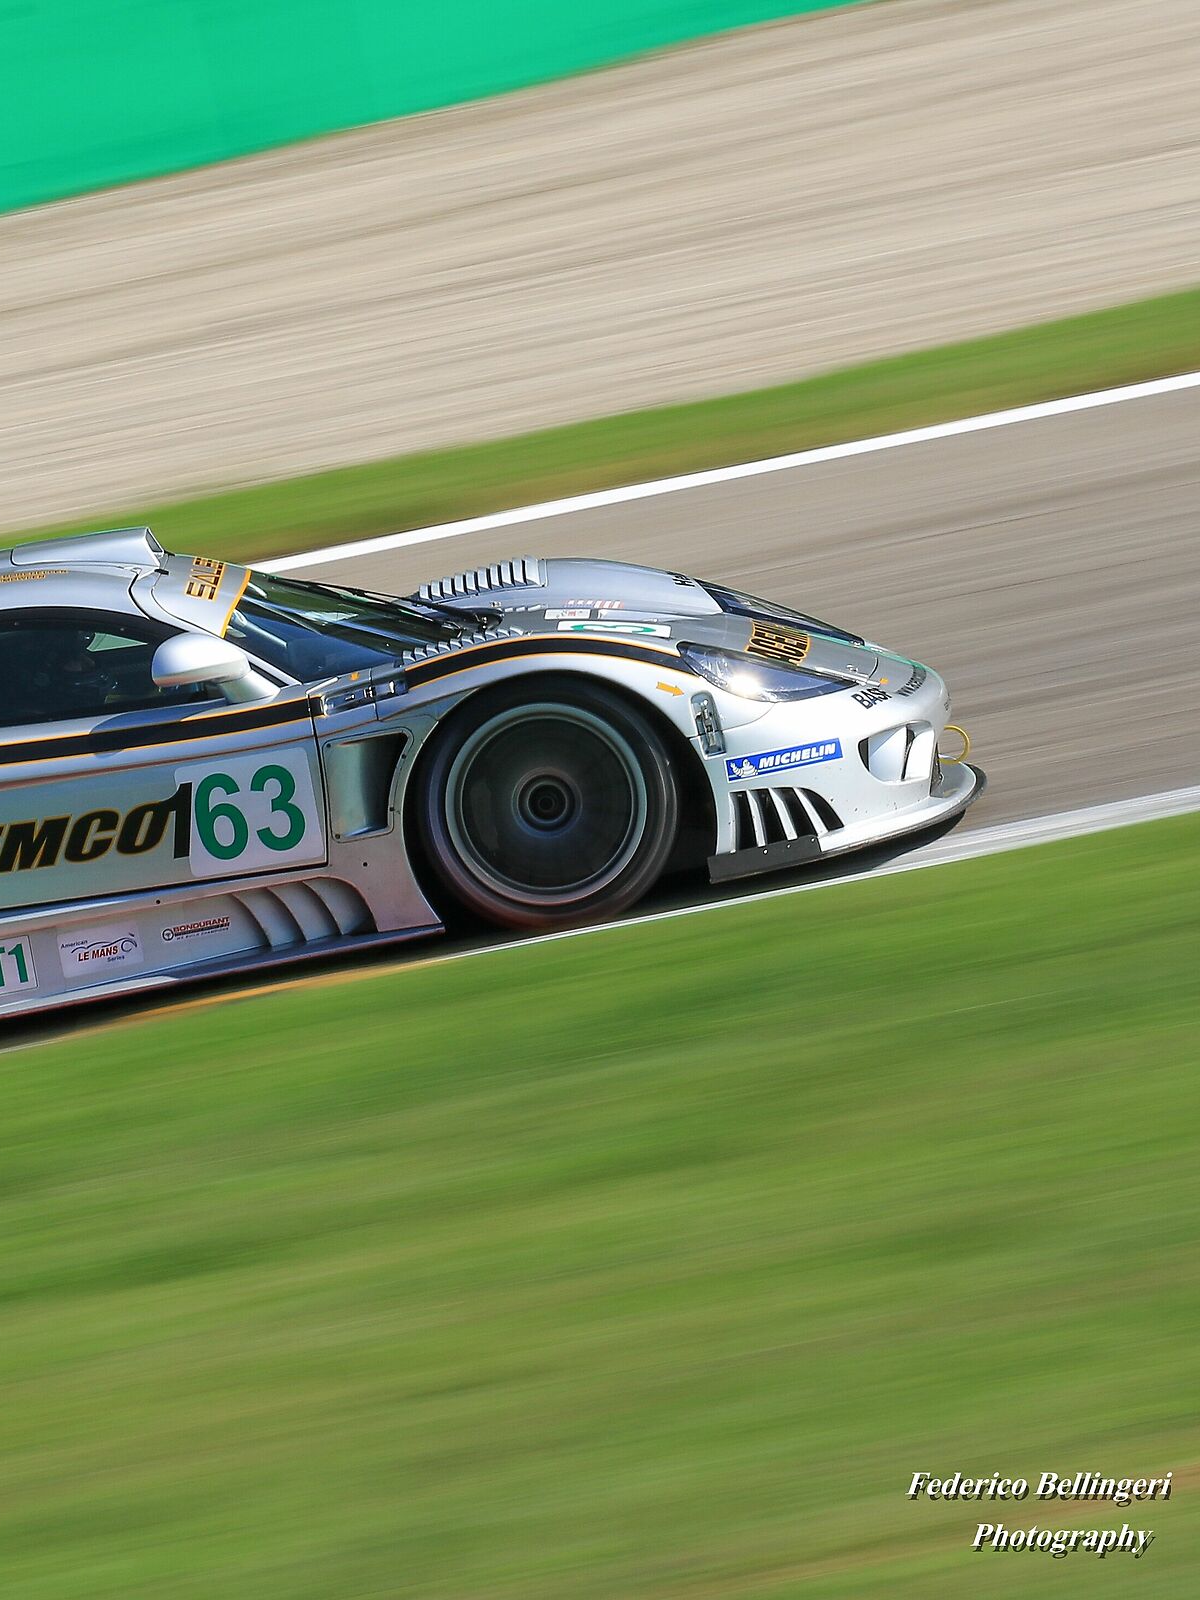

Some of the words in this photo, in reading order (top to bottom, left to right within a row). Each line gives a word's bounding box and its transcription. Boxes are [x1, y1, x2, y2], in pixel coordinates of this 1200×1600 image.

[758, 743, 837, 769] MICHELIN
[78, 951, 90, 962] LE
[92, 945, 118, 960] MANS
